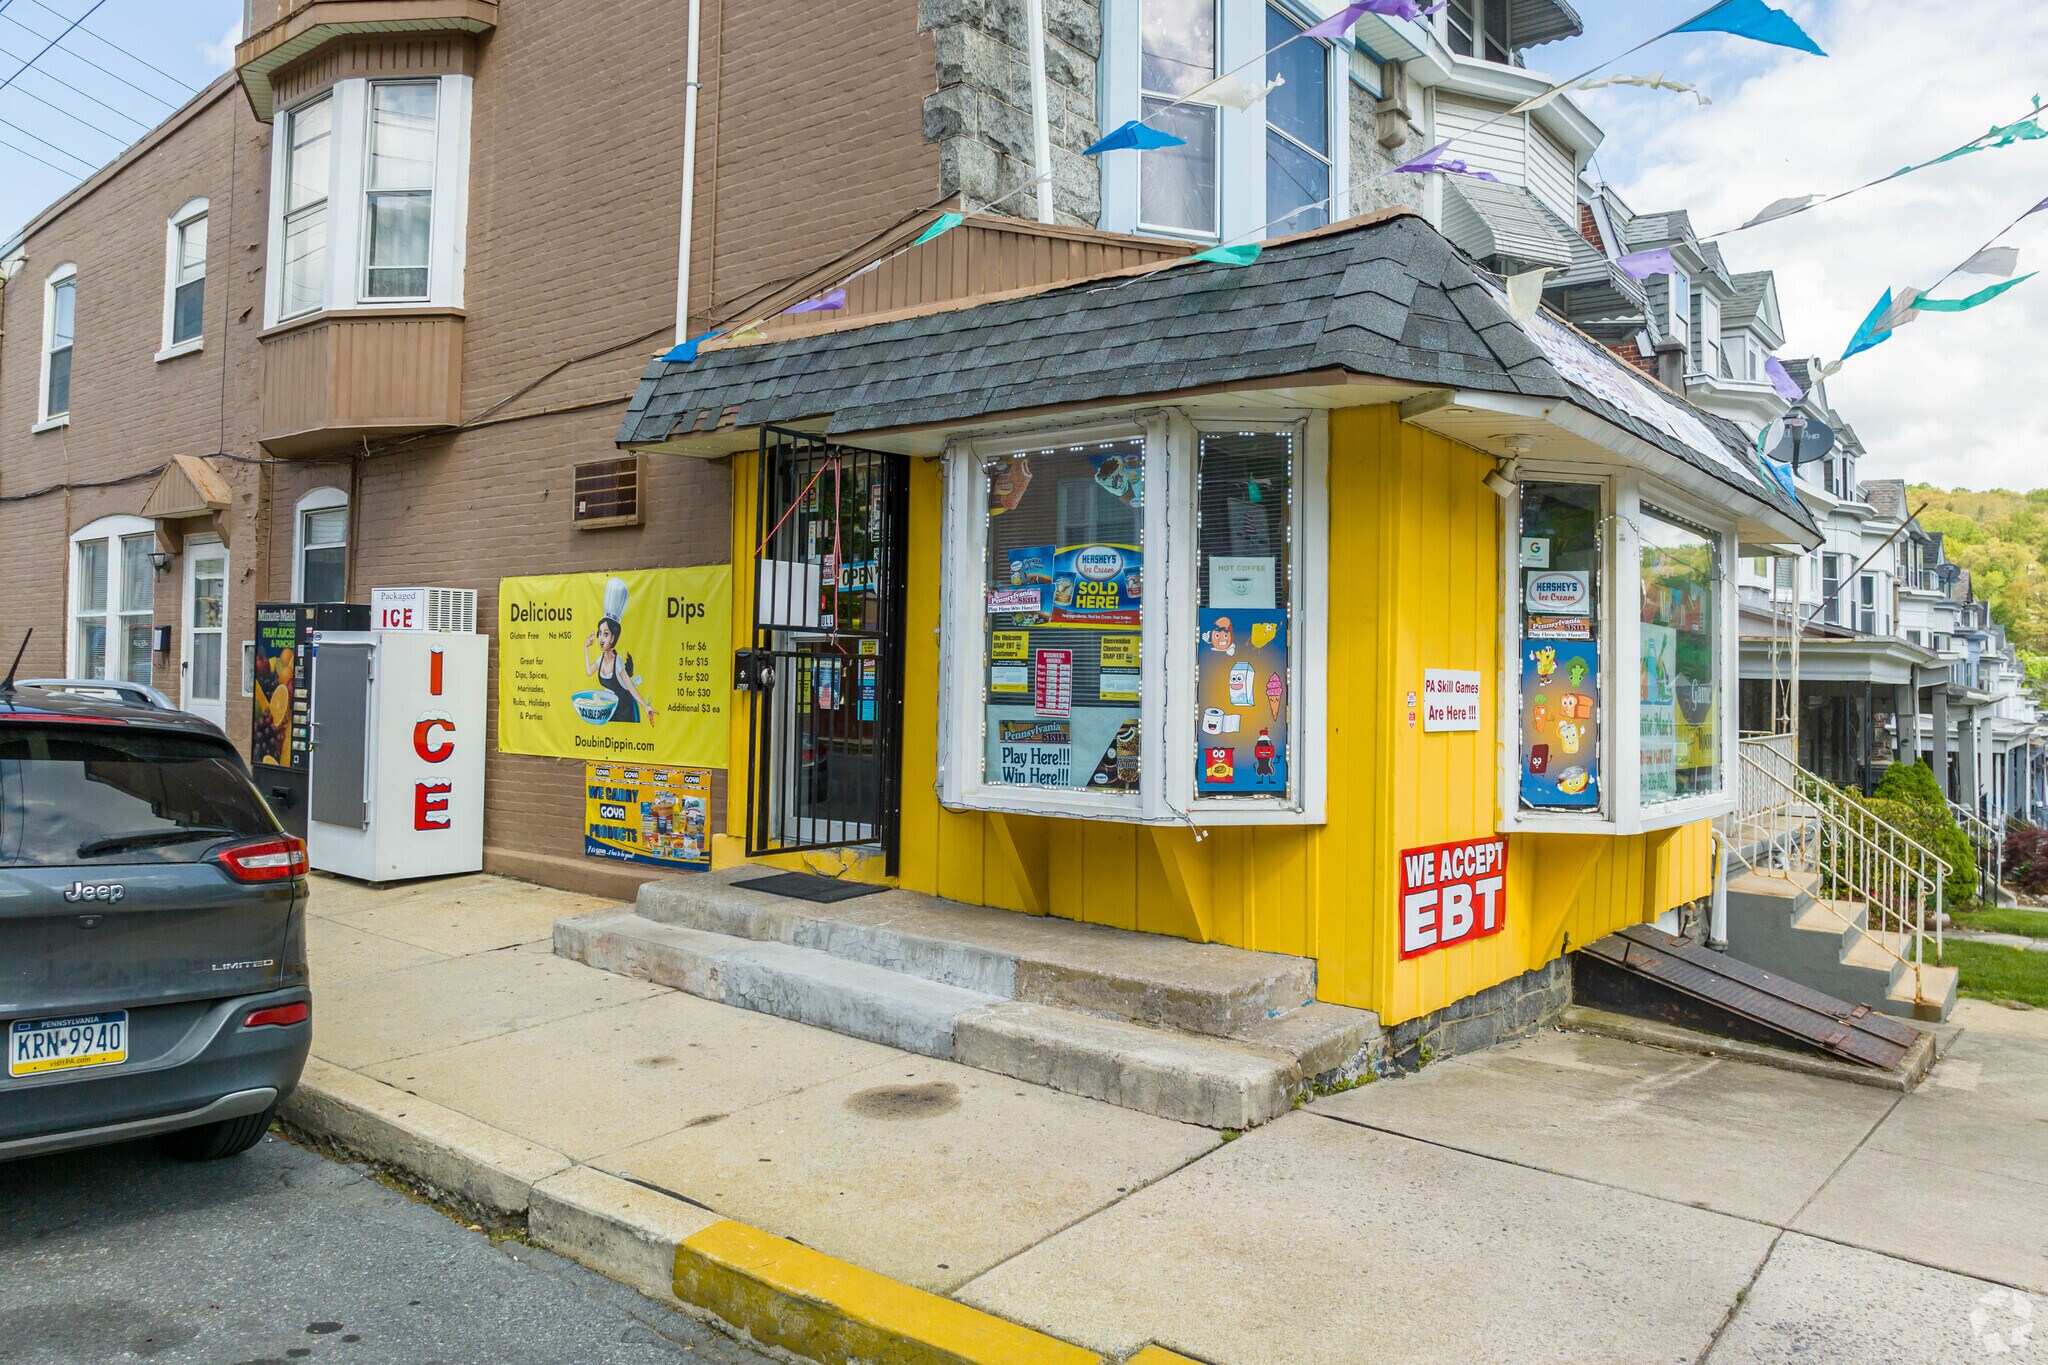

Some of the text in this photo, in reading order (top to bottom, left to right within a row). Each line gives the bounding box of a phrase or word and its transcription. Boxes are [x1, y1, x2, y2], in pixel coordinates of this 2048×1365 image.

[1082, 554, 1116, 564] HERSHEY'S
[1084, 565, 1114, 573] Ice Cream
[843, 566, 874, 586] OPEN
[1079, 582, 1118, 595] SOLD
[1537, 583, 1577, 592] HERSHEY'S
[381, 592, 416, 602] Packaged
[1076, 596, 1118, 609] HERE!
[1539, 593, 1576, 601] Ice Cream
[258, 610, 296, 621] Minute Maid
[510, 602, 572, 621] Delicious
[667, 597, 705, 624] Dips
[383, 608, 412, 628] ICE
[1533, 618, 1580, 630] Pennsylvania
[263, 628, 295, 638] FRUIT JUICES
[276, 640, 295, 648] PUNCHES
[686, 642, 695, 650] for
[698, 642, 706, 651] $6
[520, 657, 534, 665] Great
[679, 657, 708, 666] 3 for $15
[516, 671, 548, 680] Dips, Spices,
[678, 672, 709, 682] 5 for $20
[517, 685, 546, 694] Marinades,
[1426, 679, 1478, 694] PA Skill Games
[677, 688, 711, 698] 10 for $30
[1692, 679, 1711, 711] Game
[513, 698, 550, 708] Rubs, Holidays
[668, 703, 700, 712] Additional
[702, 704, 710, 713] $3
[525, 712, 543, 720] Parties
[1428, 705, 1476, 720] Are Here !!!
[414, 643, 456, 831] ICE
[1005, 722, 1060, 740] Pennsylvania
[575, 735, 654, 752] DoubinDippin.com
[1002, 747, 1070, 768] Play Here!!!
[685, 776, 699, 784] GOYA
[1002, 767, 1068, 785] Win Here!!!
[588, 786, 639, 803] WE CARRY
[600, 805, 625, 820] GOYA
[590, 824, 637, 842] PRODUCTS
[1405, 841, 1504, 888] WE ACCEPT
[64, 882, 126, 904] Jeep
[1404, 876, 1502, 952] EBT
[212, 959, 274, 971] LIMITED
[41, 1016, 99, 1028] PENNSYLVANIA
[50, 1056, 91, 1067] visitPA.com
